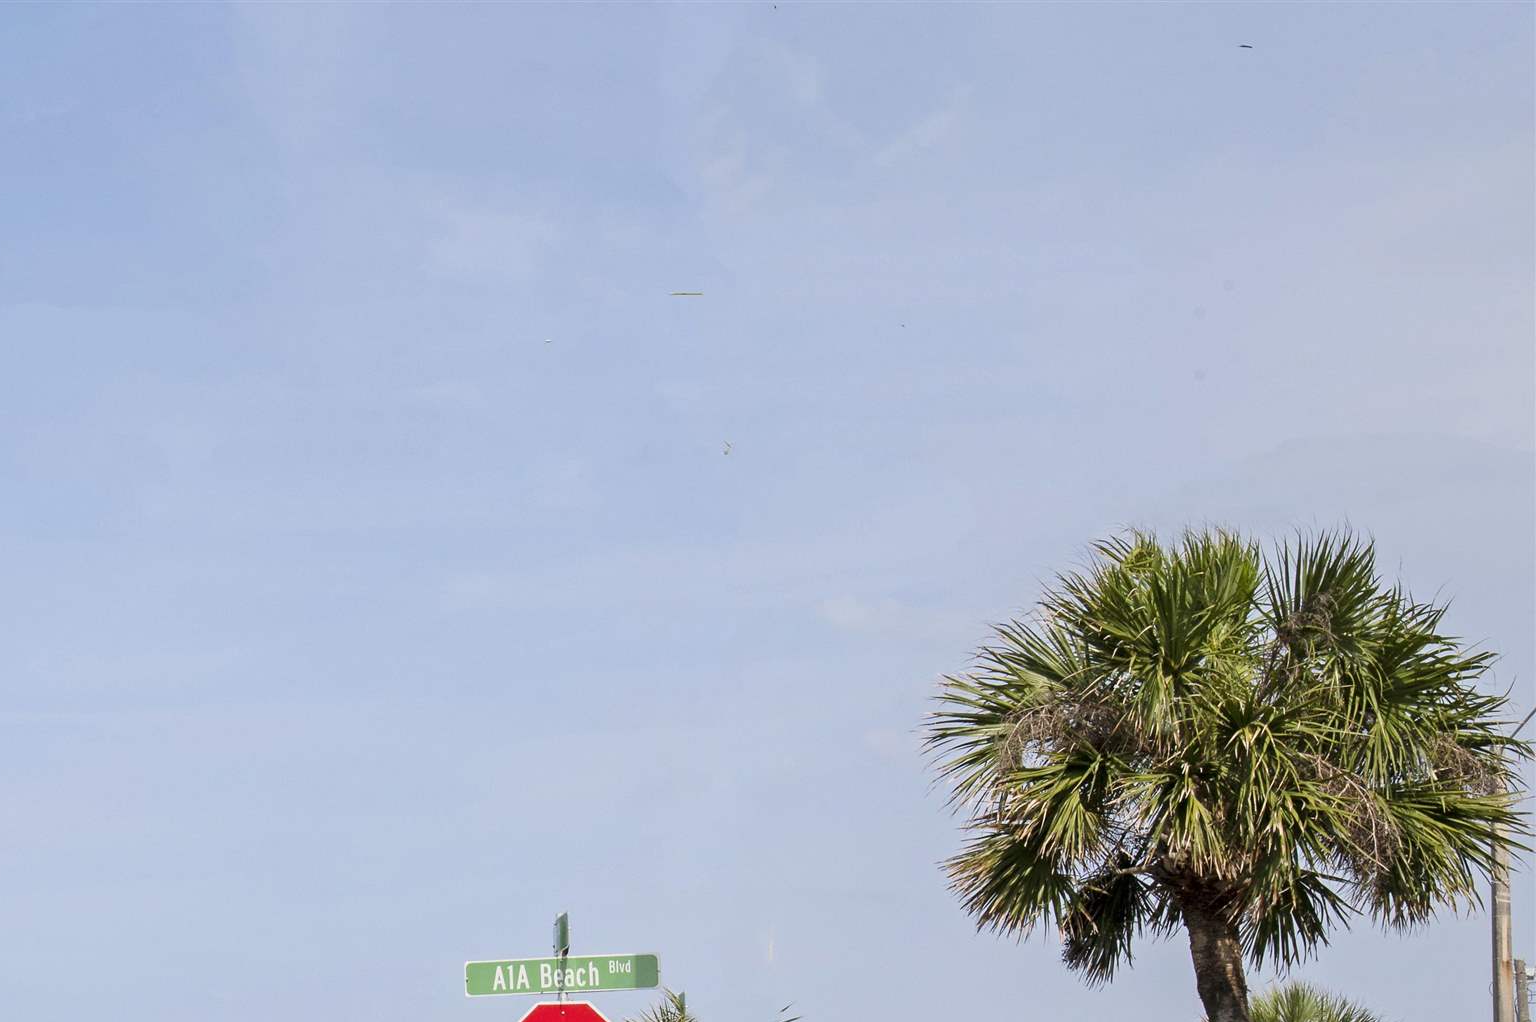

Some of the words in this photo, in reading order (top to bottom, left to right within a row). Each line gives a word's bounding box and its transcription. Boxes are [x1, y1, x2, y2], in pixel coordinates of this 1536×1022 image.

[492, 964, 530, 991] A1A
[540, 961, 600, 988] Beach
[608, 960, 631, 974] Blvd
